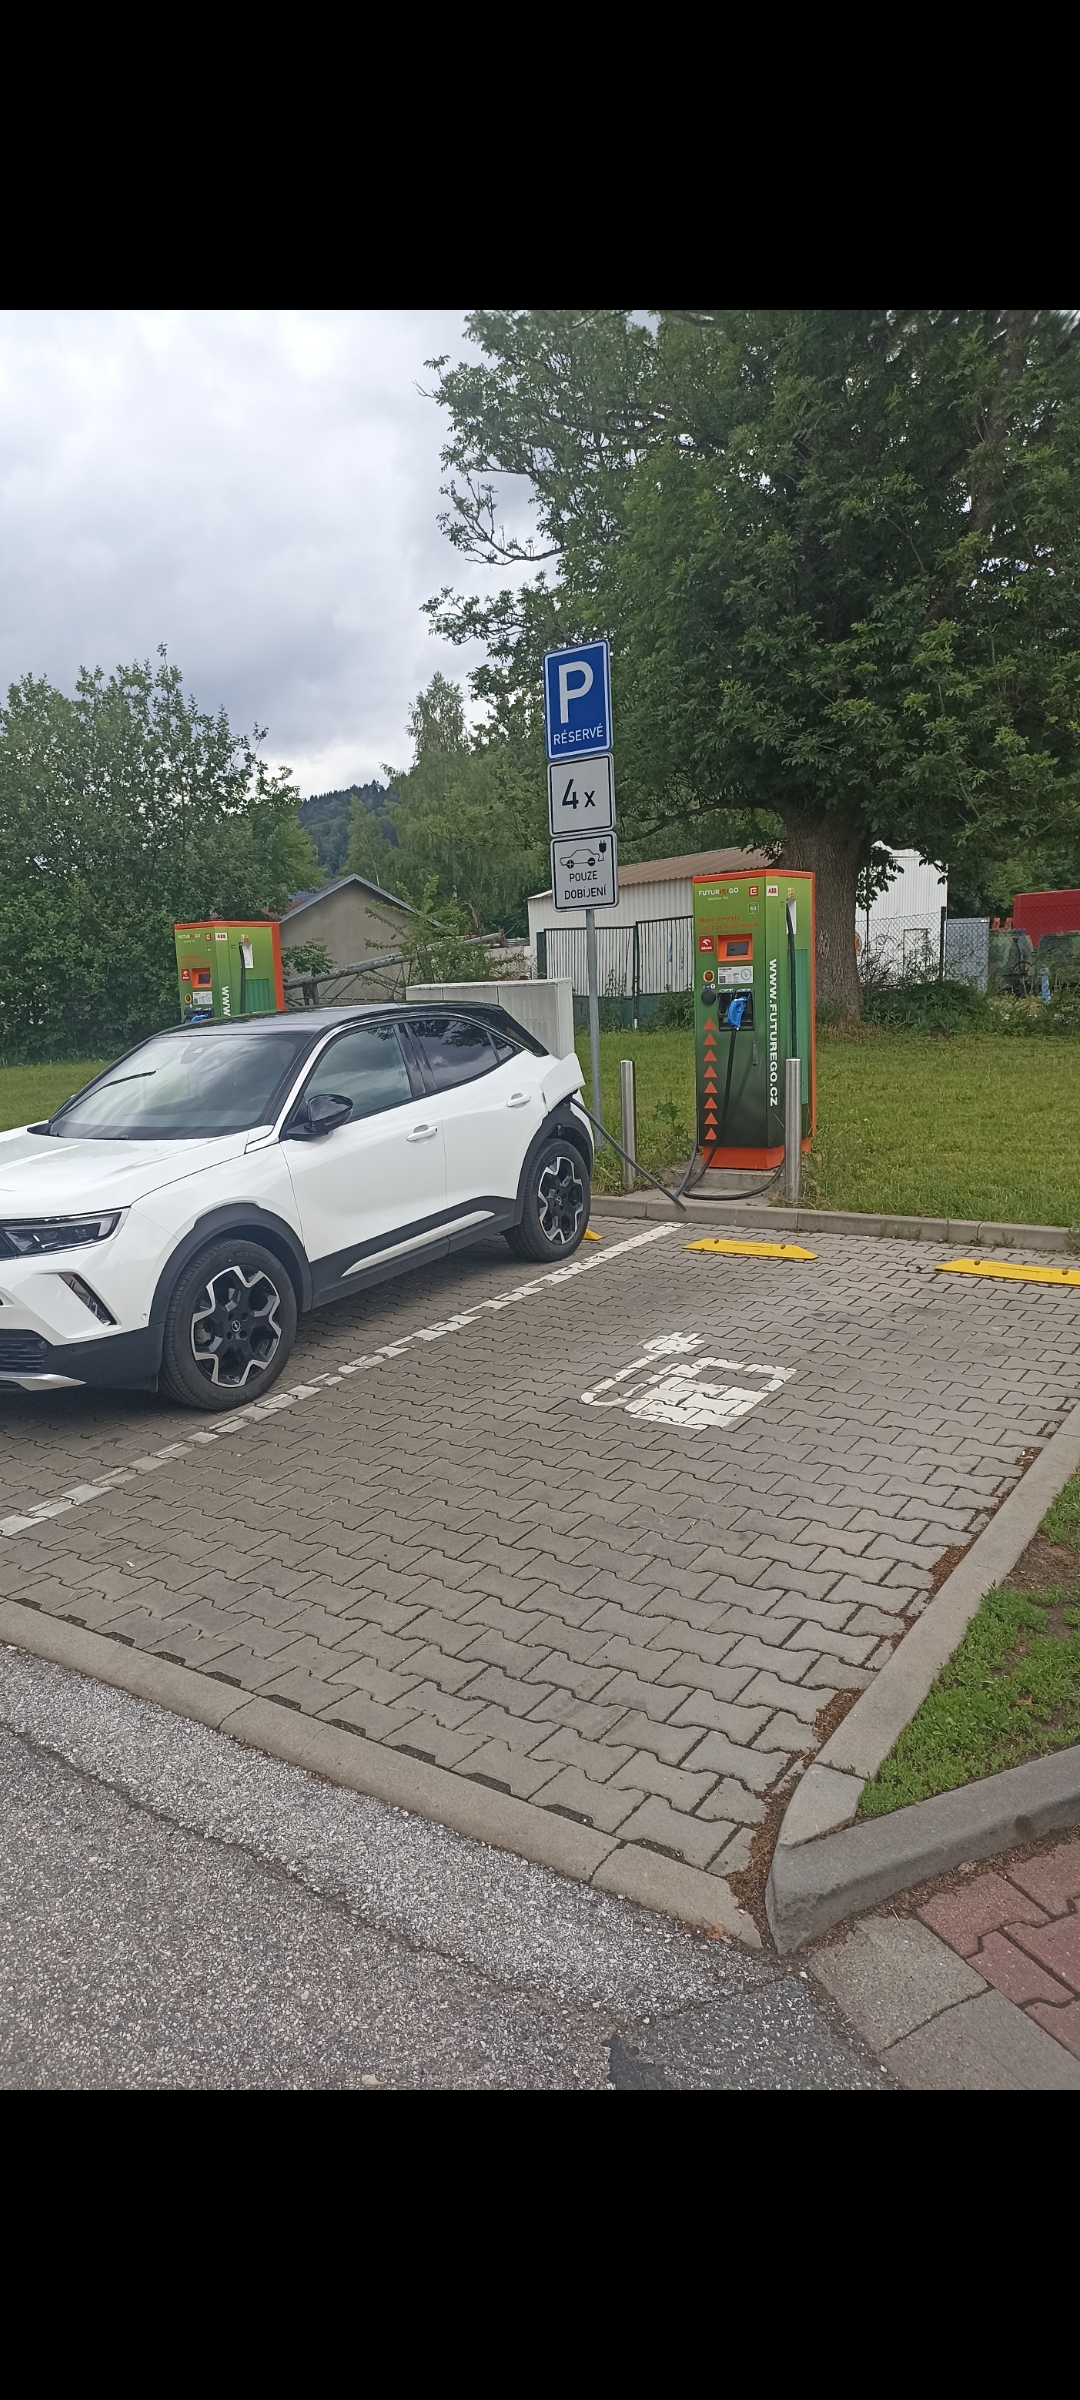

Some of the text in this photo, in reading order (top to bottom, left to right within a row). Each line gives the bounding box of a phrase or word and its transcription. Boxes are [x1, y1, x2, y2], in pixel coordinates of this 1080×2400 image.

[558, 660, 594, 724] P
[553, 722, 604, 746] RÉSERVÉ
[569, 870, 598, 883] POUZE
[564, 884, 607, 901] DOBÍJENÍ
[769, 958, 778, 1107] WWW.FUTUREGO.CZ
